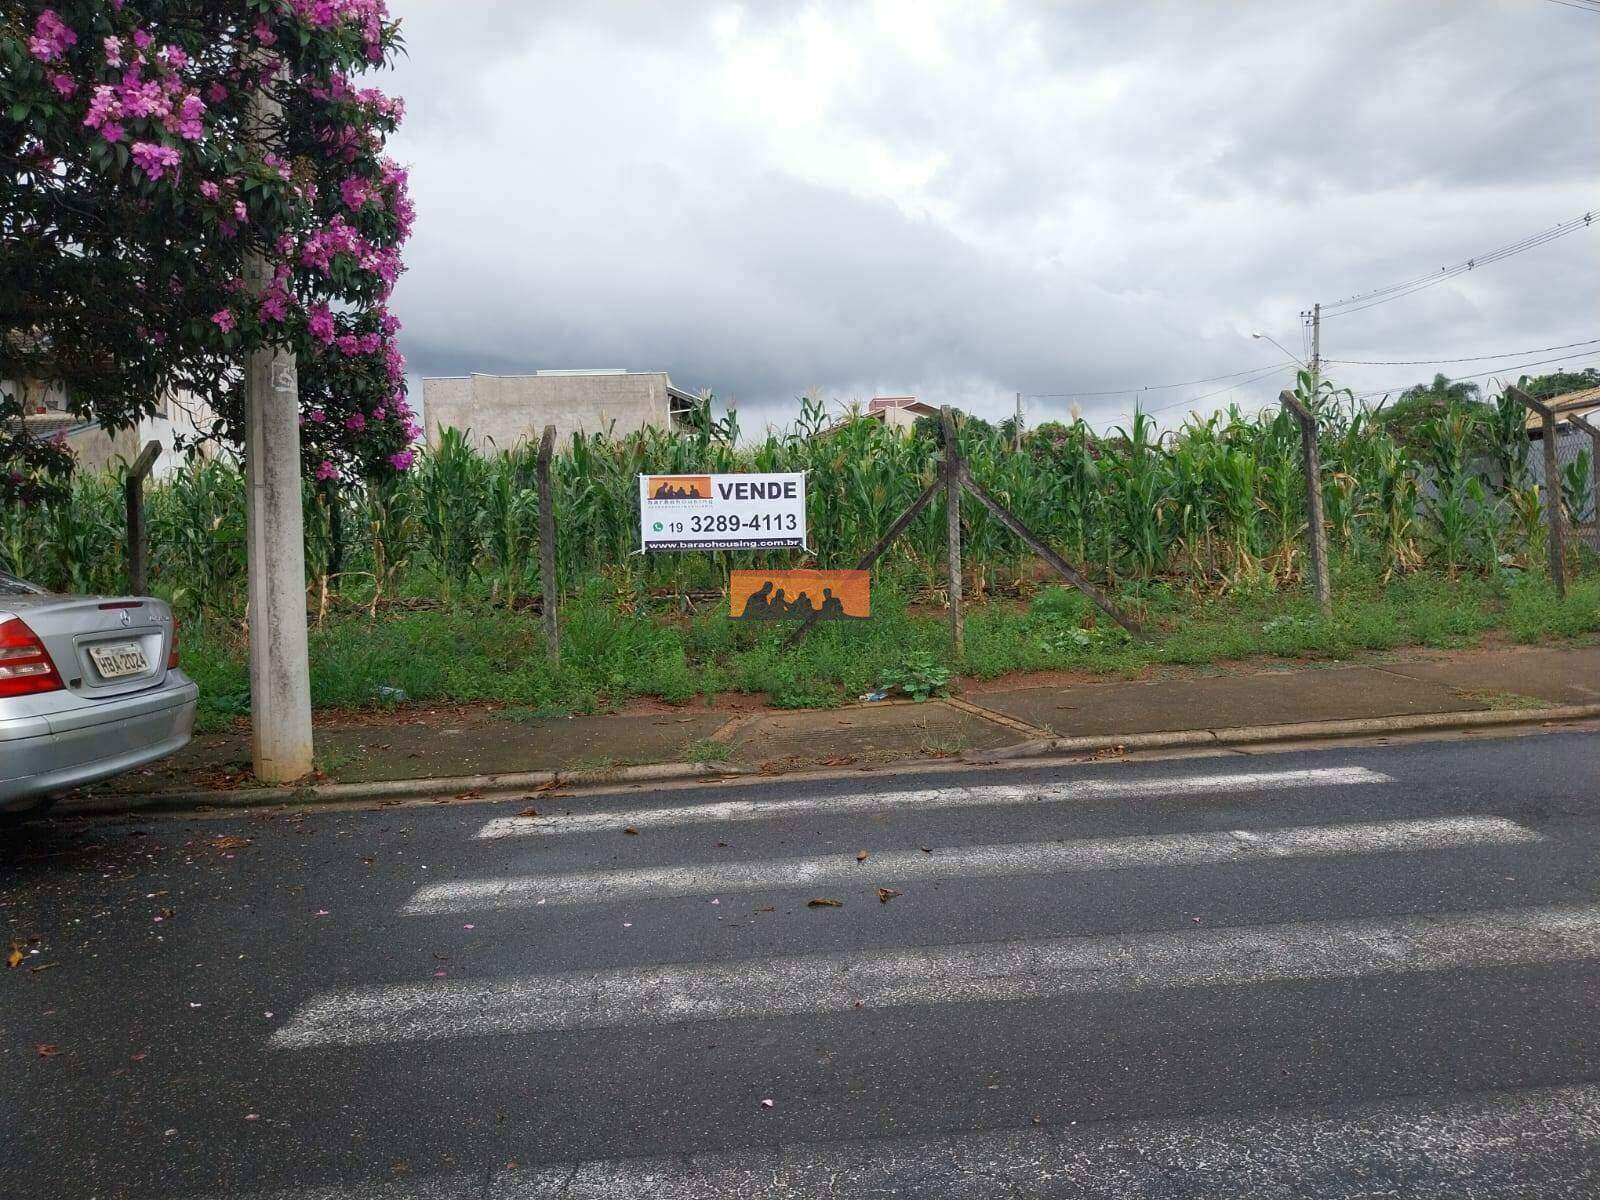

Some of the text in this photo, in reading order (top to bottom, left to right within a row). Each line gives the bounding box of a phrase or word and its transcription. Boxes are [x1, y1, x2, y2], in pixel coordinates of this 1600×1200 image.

[718, 482, 797, 500] VENDE
[668, 513, 797, 533] 19 3289-4113
[649, 539, 799, 549] www.baraohousing.com.br
